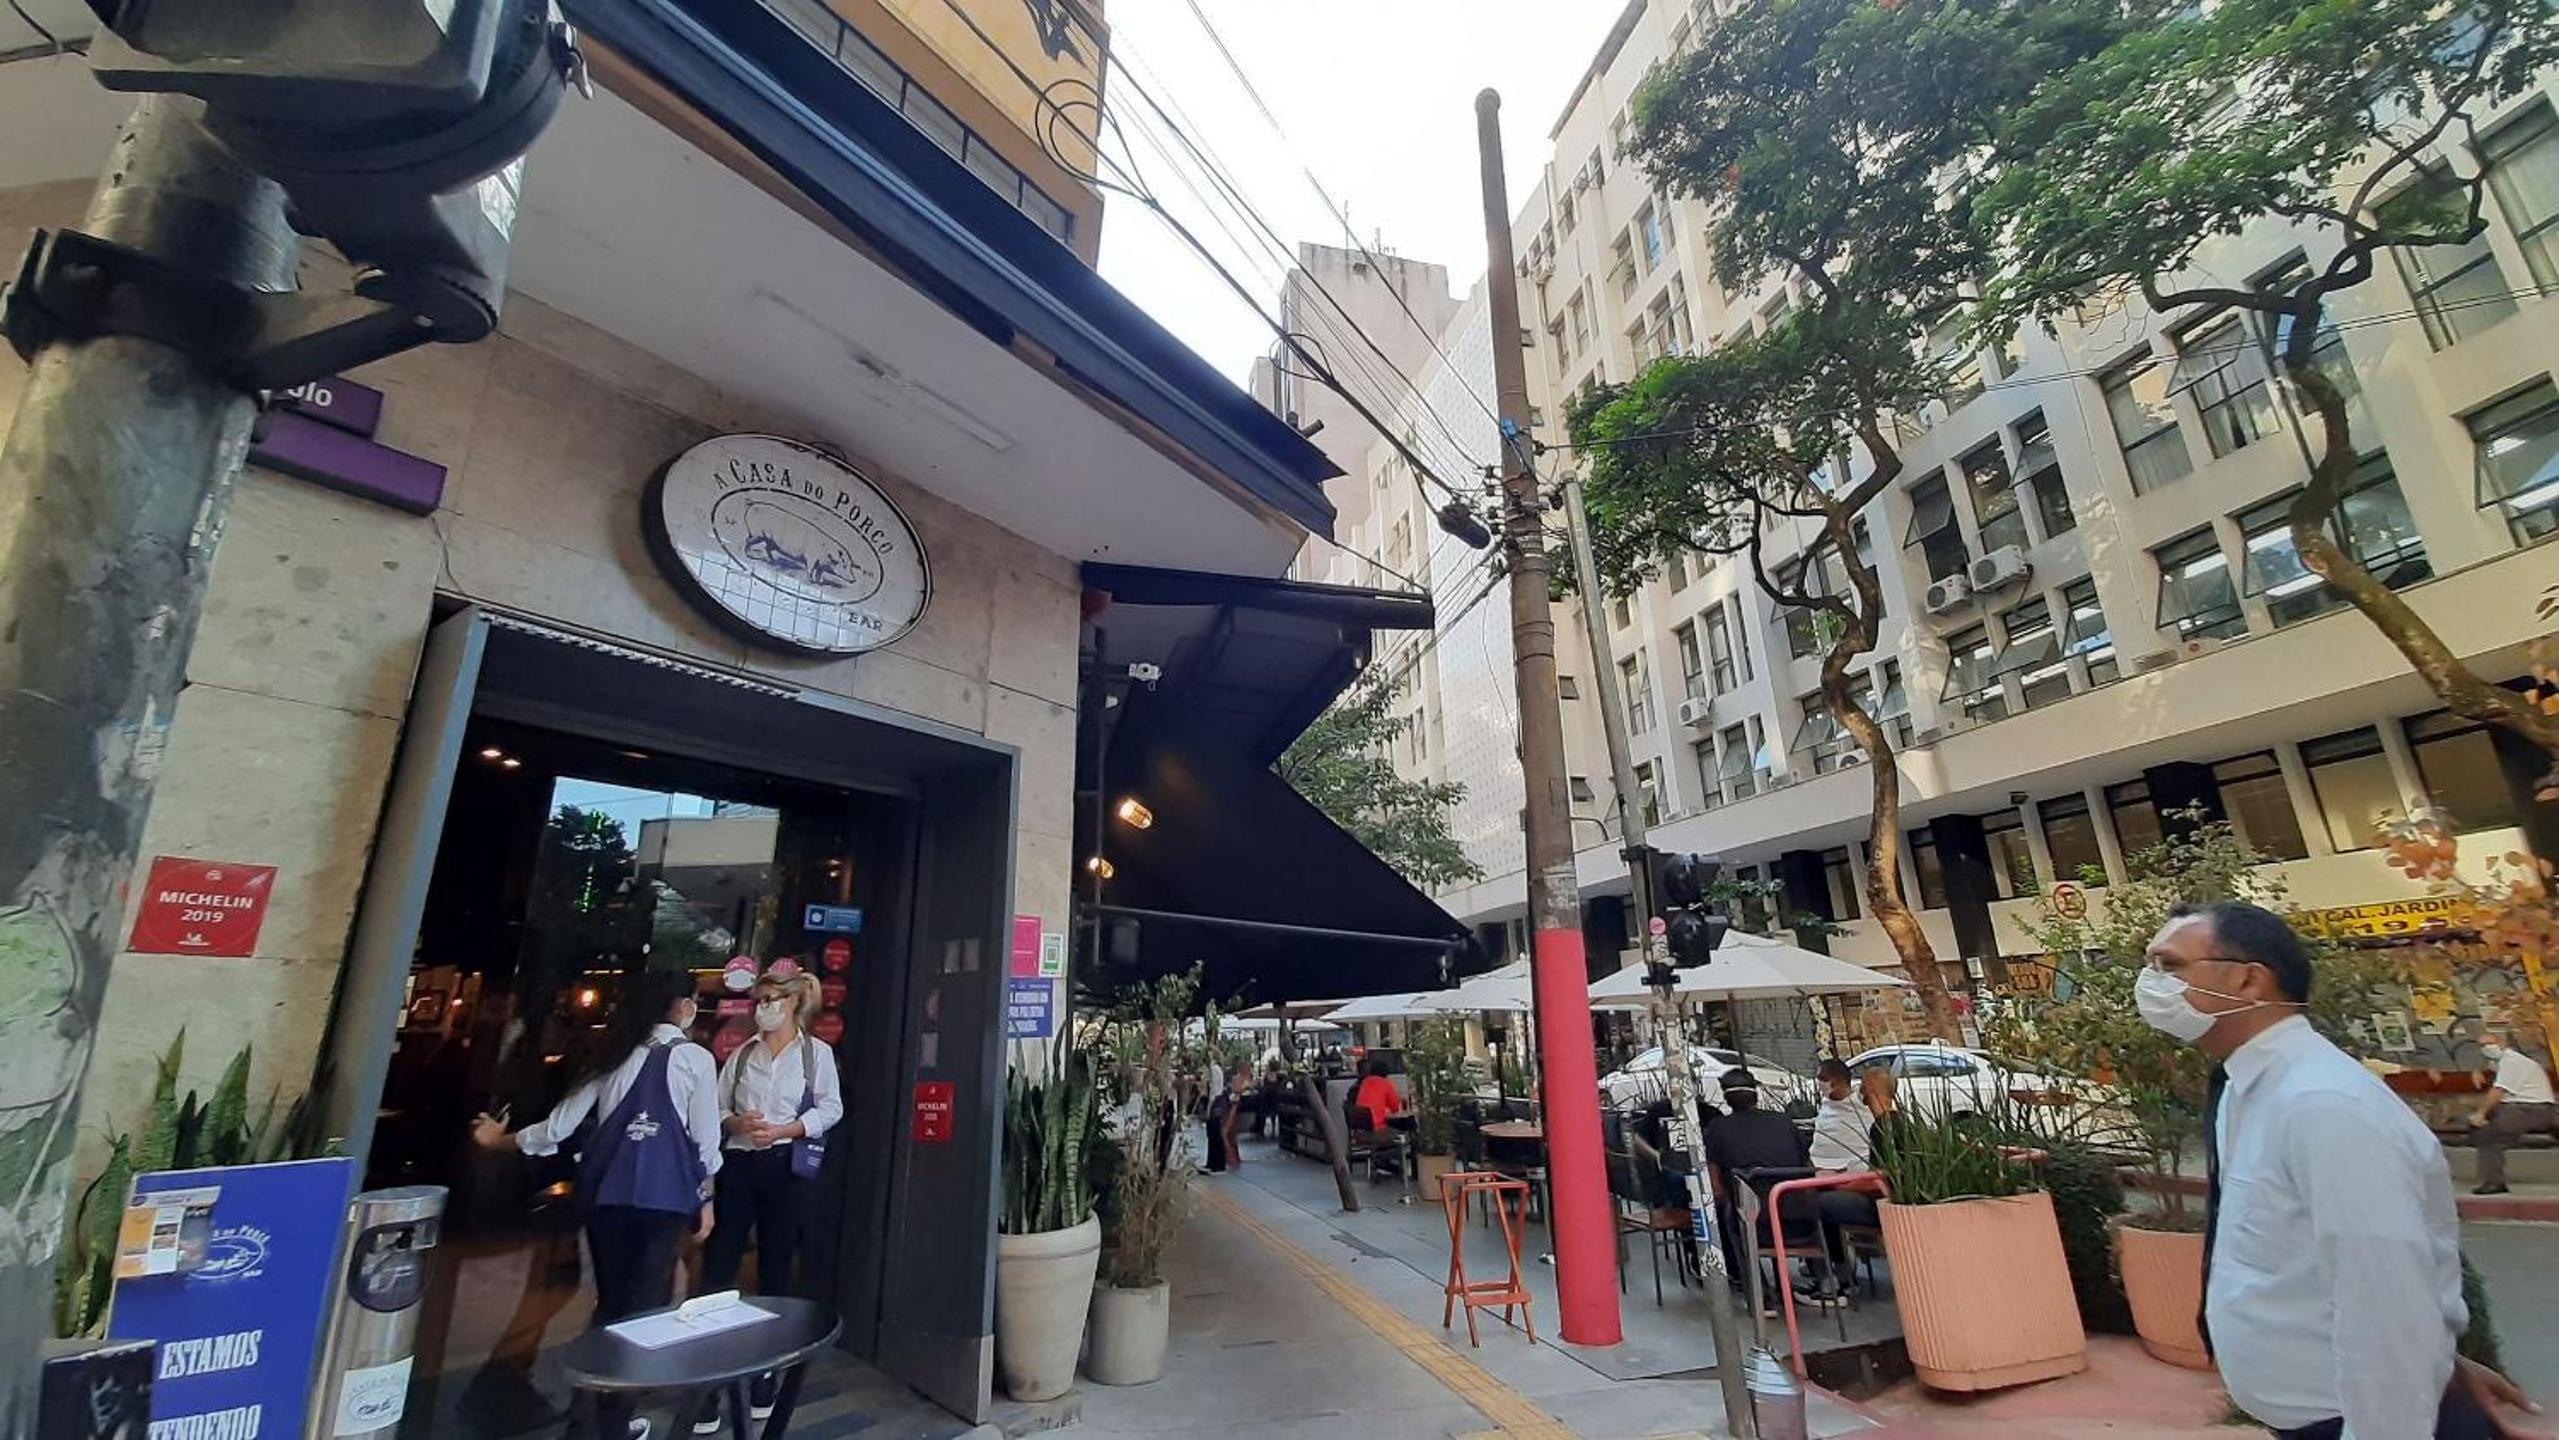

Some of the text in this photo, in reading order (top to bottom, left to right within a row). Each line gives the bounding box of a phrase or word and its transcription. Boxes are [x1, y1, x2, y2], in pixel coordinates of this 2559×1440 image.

[713, 472, 728, 490] A
[159, 891, 253, 909] MICHELIN
[181, 909, 224, 923] 2019
[159, 1330, 263, 1380] ESTAMOS
